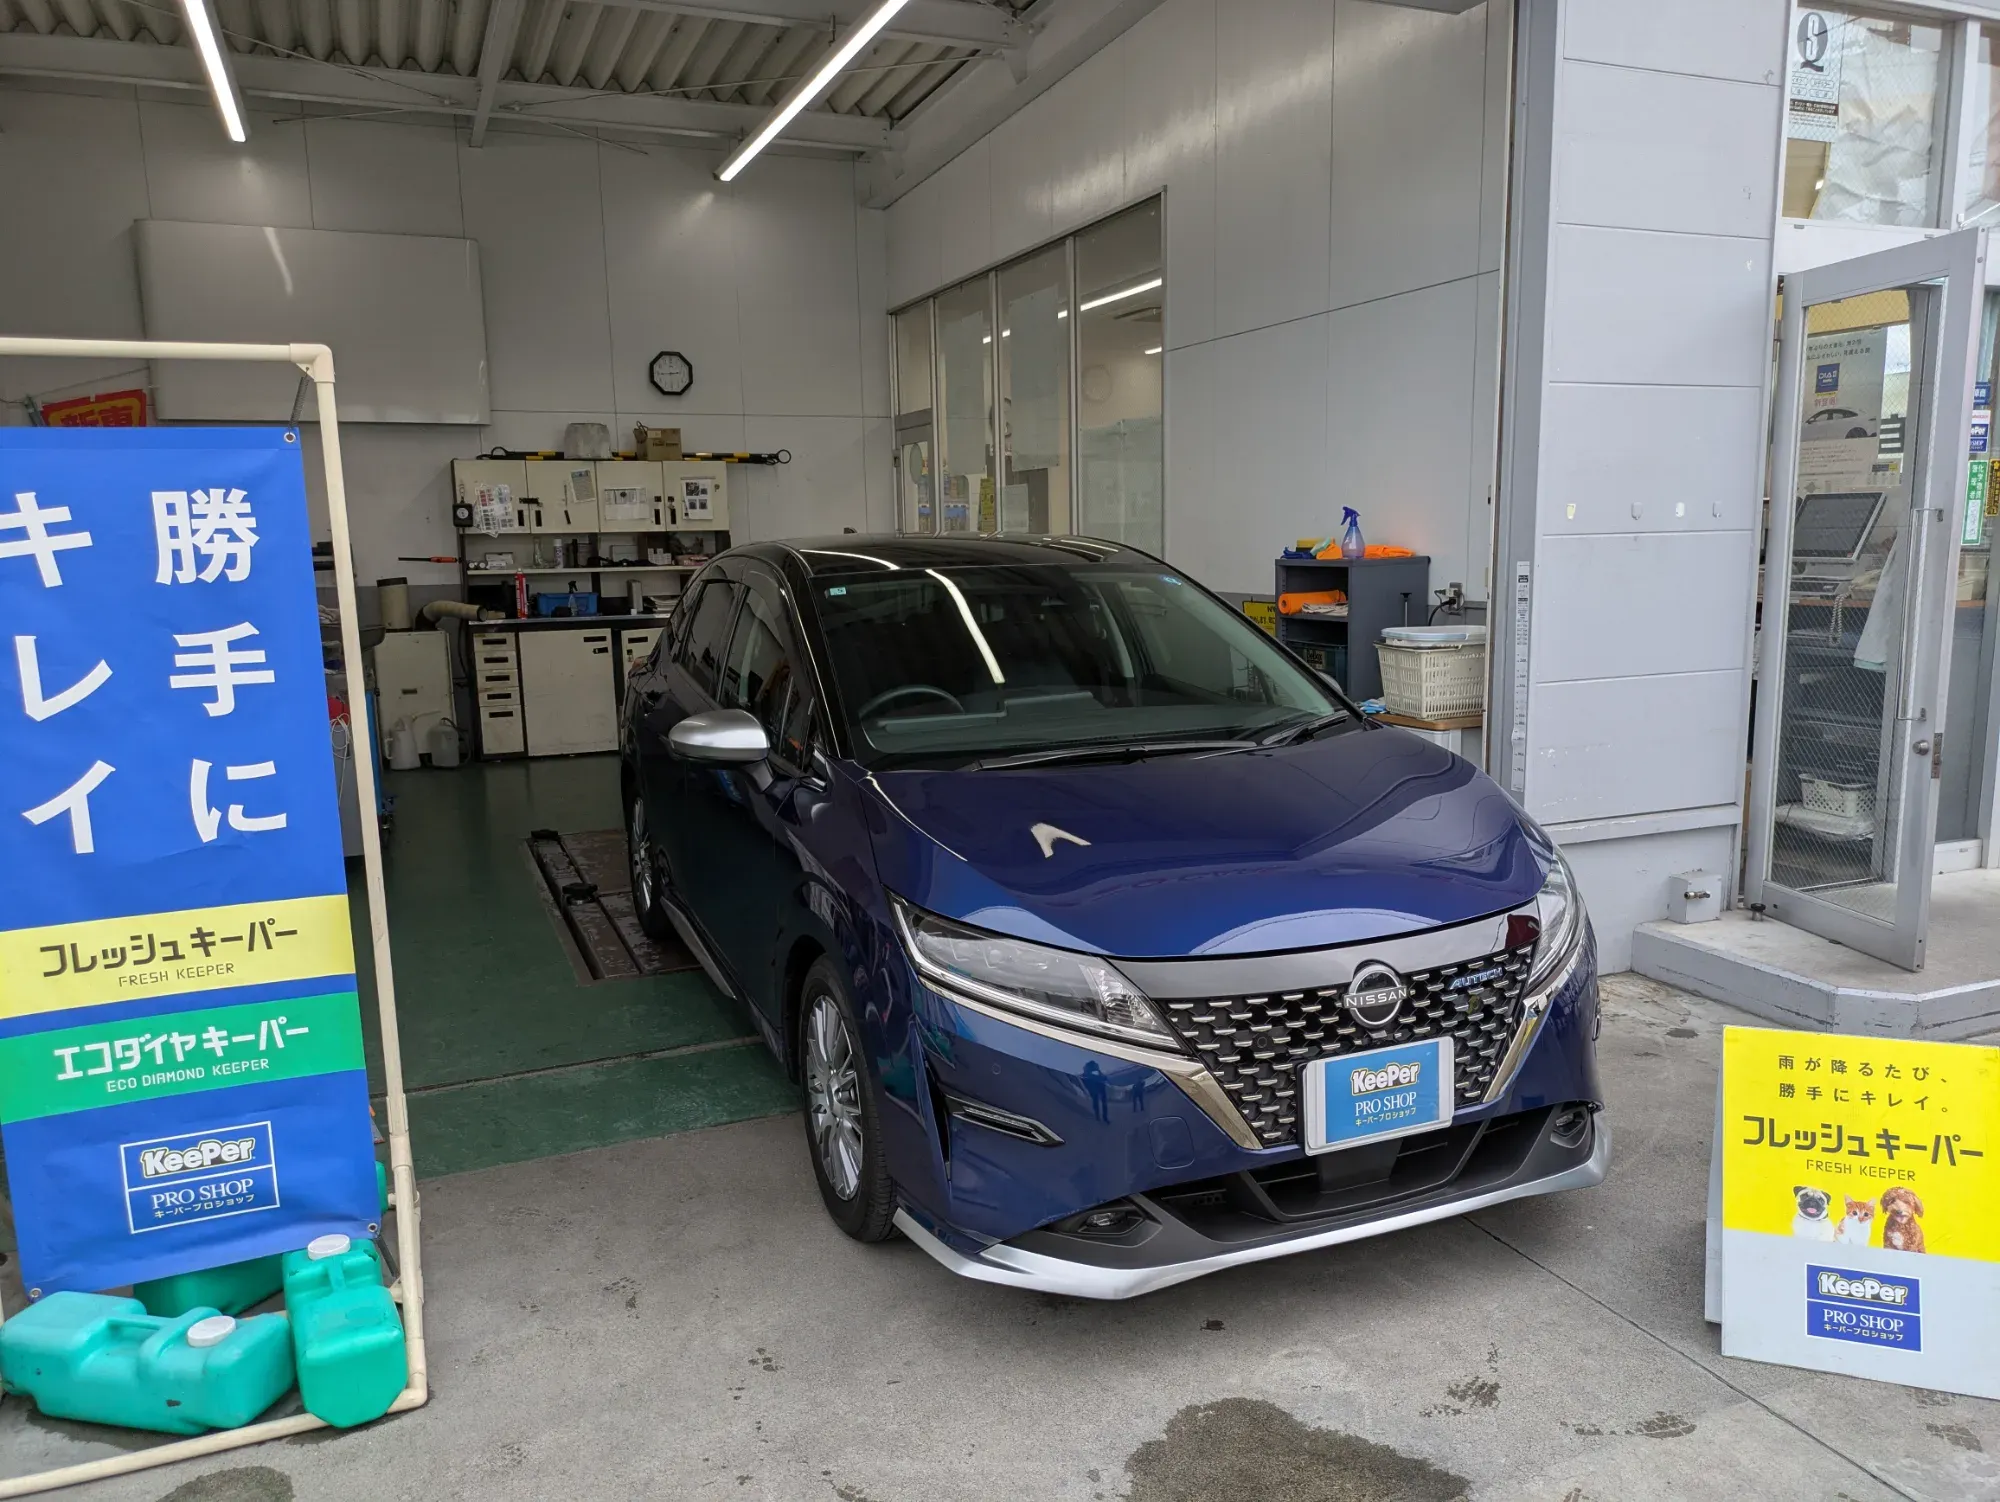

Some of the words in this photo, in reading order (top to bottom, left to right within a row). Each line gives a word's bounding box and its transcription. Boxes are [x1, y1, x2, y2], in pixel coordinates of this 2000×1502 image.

[0, 491, 116, 854] キレイ
[151, 488, 287, 844] 勝手に
[40, 917, 298, 978] フレッシュキーパー
[119, 971, 169, 988] FRESH
[176, 962, 235, 980] KEEPER
[1450, 967, 1503, 990] AUTECH
[1345, 987, 1407, 1007] NISSAN
[53, 1016, 309, 1081] エコダイヤキーパー
[107, 1077, 137, 1093] ECO
[142, 1067, 205, 1088] DIAMOND
[212, 1058, 269, 1077] KEEPER
[1351, 1062, 1420, 1096] KeePer
[1778, 1055, 1948, 1083] 雨が降るたび、
[1355, 1098, 1381, 1117] PRO
[1383, 1091, 1416, 1111] SHOP
[1779, 1083, 1948, 1113] 勝手にキレイ。
[1356, 1107, 1416, 1126] キーパープロショップ
[1743, 1115, 1984, 1167] フレッシュキーパー
[140, 1138, 255, 1178] KeePer
[1806, 1159, 1852, 1175] FRESH
[1859, 1165, 1916, 1182] KEEPER
[152, 1188, 195, 1209] PRO
[200, 1178, 253, 1201] SHOP
[154, 1194, 255, 1218] キーパープロショップ
[1818, 1271, 1908, 1305] KeePer
[1823, 1308, 1856, 1325] PRO
[1860, 1314, 1904, 1332] SHOP
[1824, 1323, 1904, 1341] キーパープロショップ
